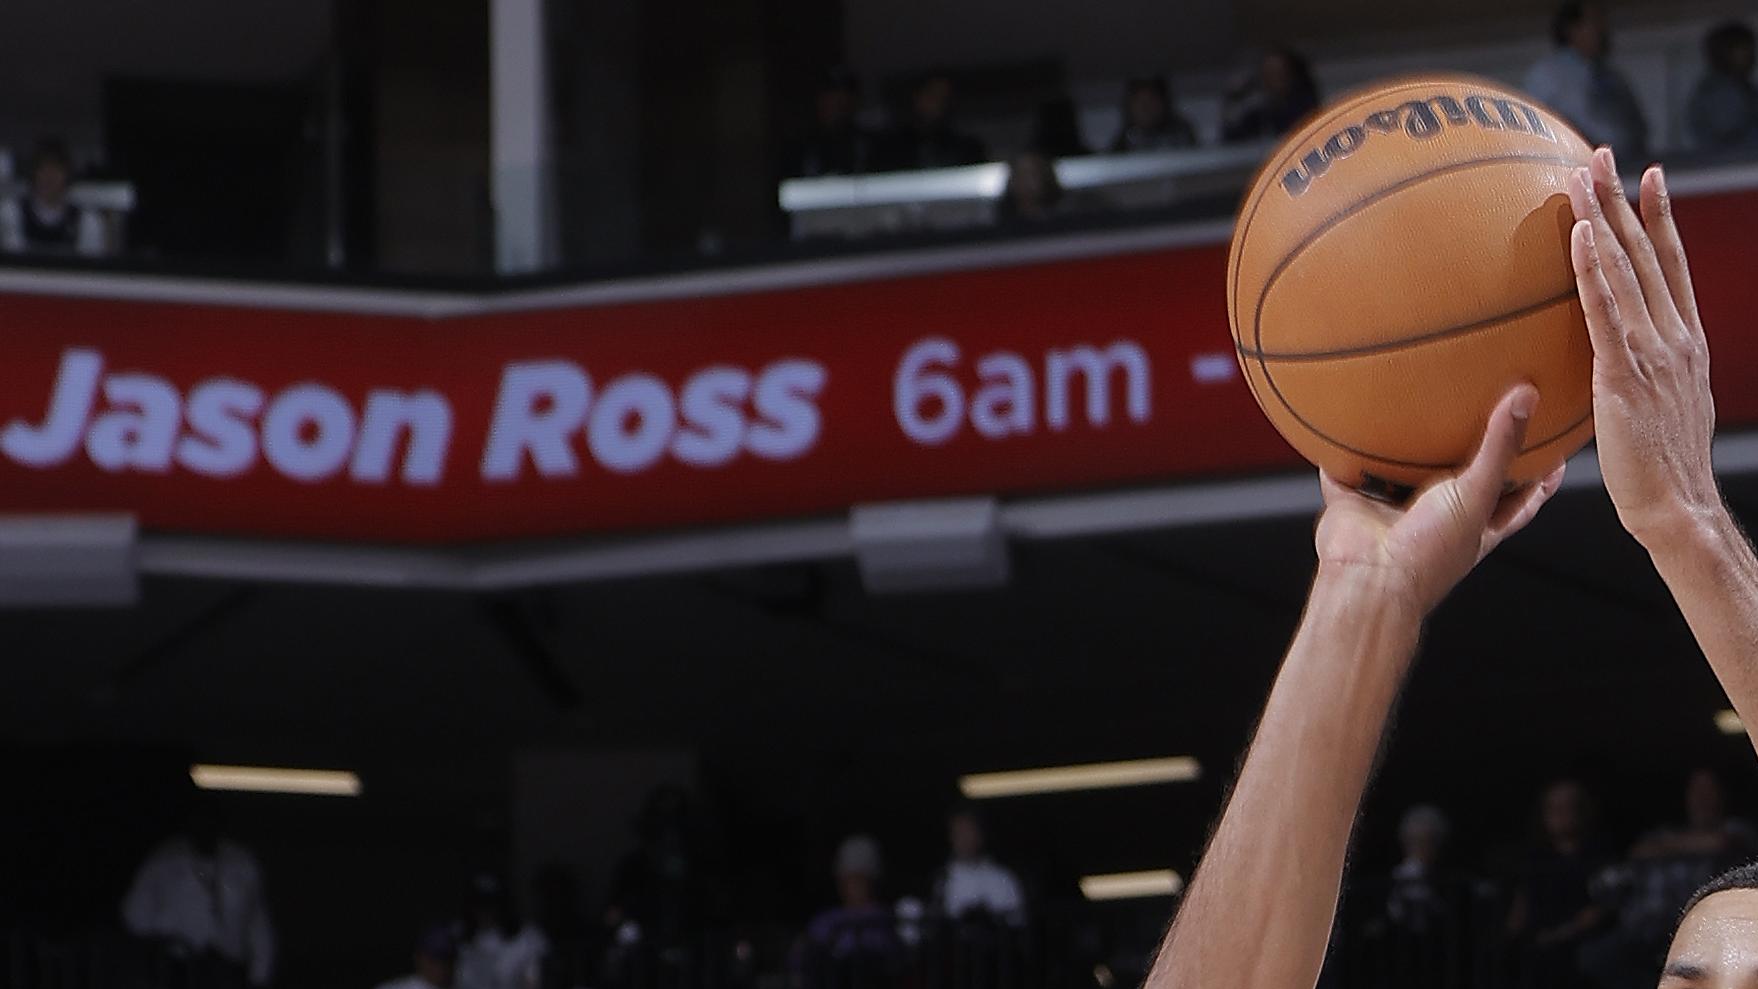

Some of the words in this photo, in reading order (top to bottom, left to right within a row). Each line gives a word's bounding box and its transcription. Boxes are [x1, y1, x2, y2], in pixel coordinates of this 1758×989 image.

[1280, 95, 1558, 198] Wilson
[1, 349, 452, 485] Jason
[482, 360, 826, 481] Ross
[895, 338, 1150, 445] 6am
